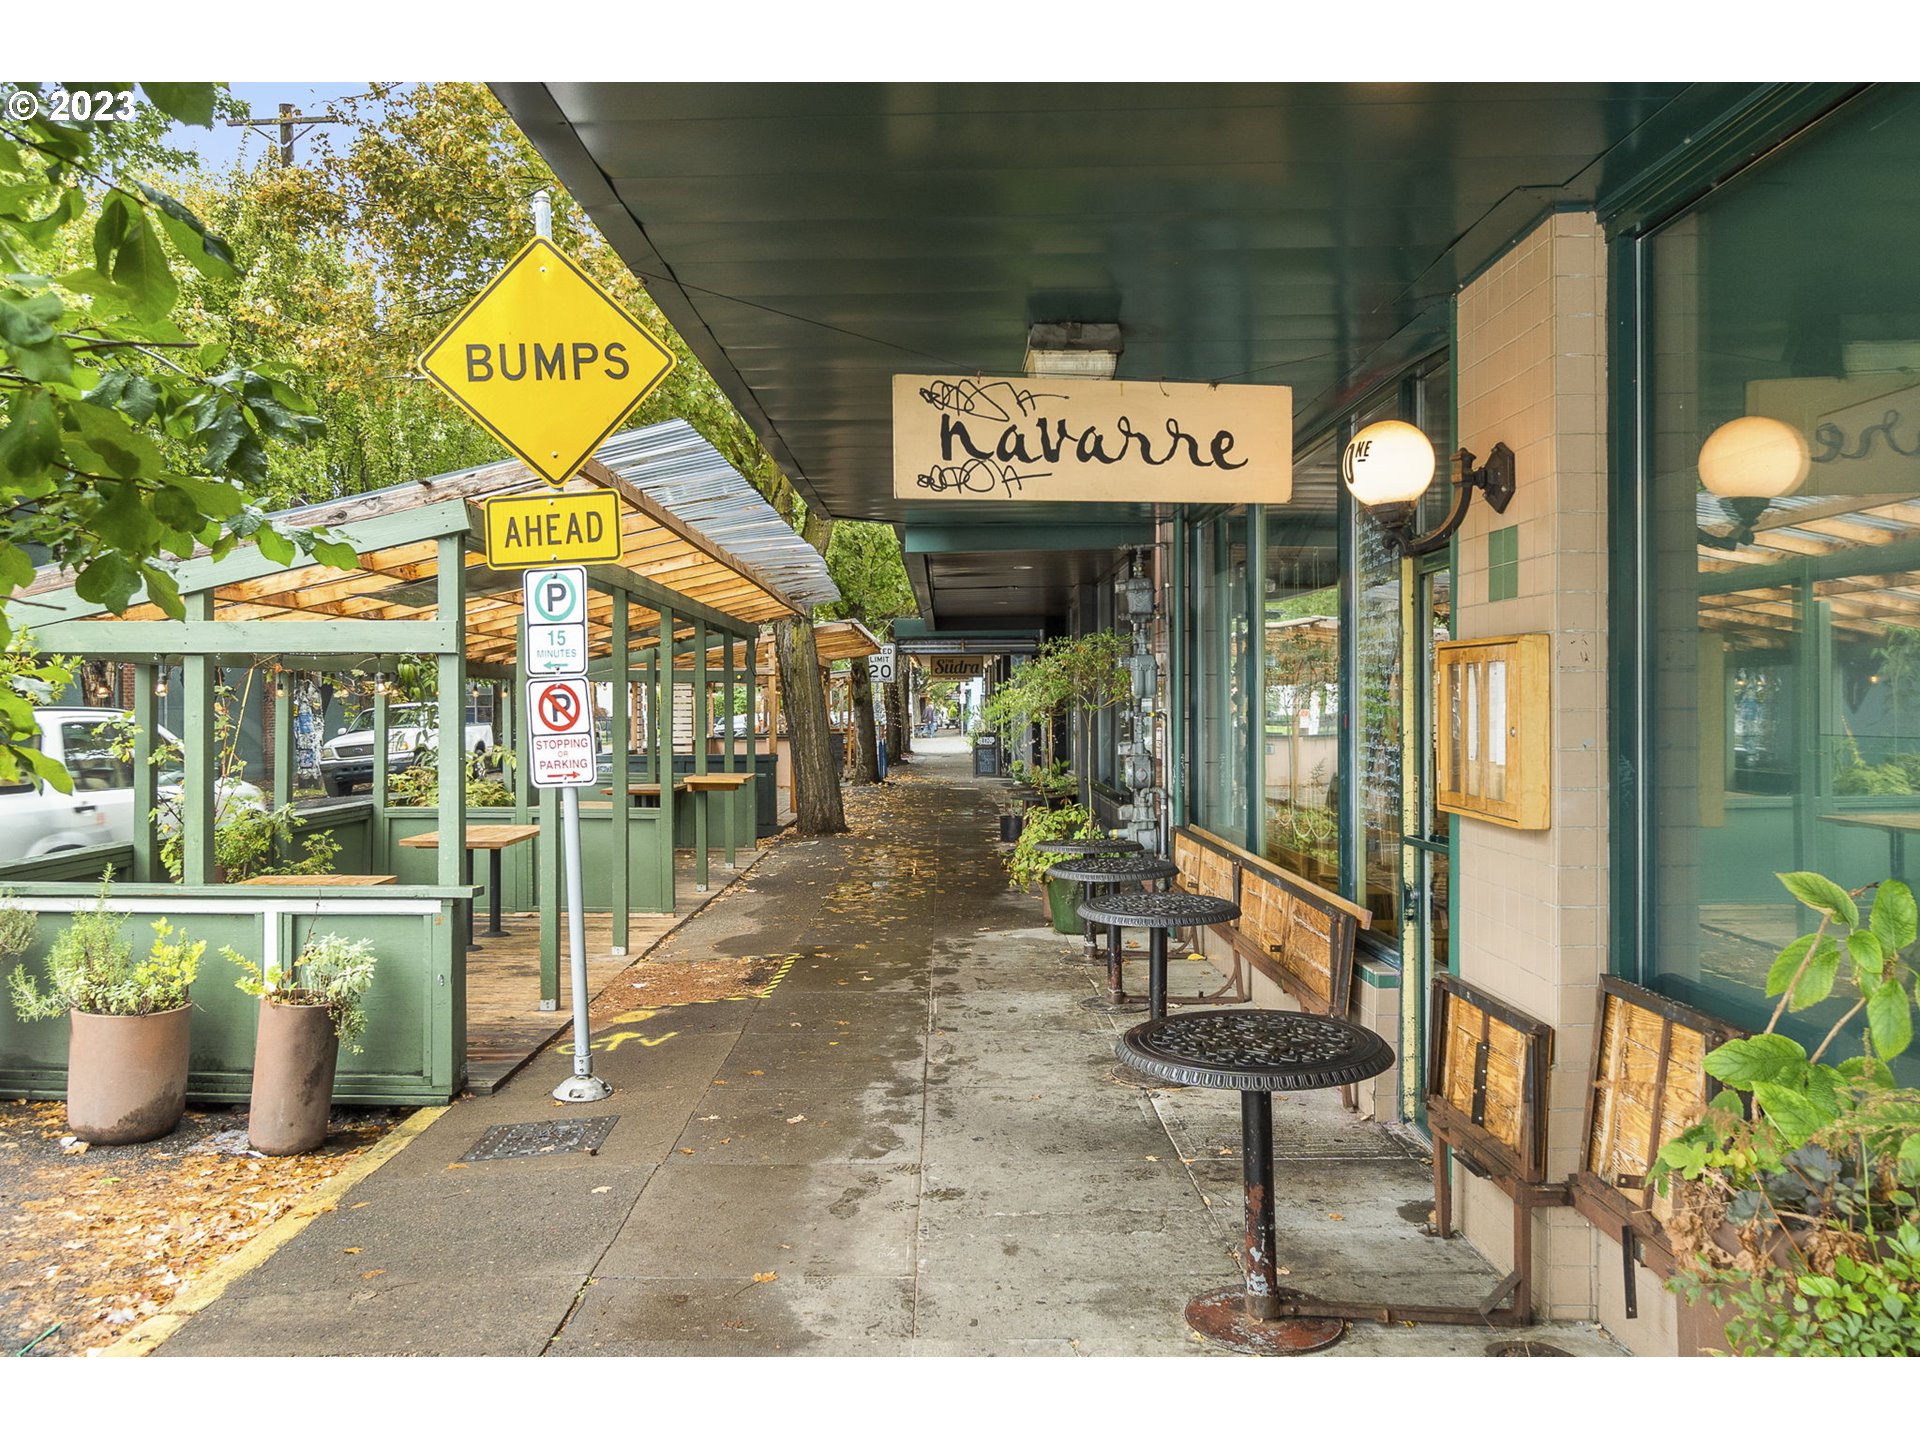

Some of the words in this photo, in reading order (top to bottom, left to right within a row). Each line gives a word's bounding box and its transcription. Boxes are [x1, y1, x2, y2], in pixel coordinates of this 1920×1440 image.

[466, 343, 629, 383] BUMPS
[940, 413, 1250, 471] navarre
[504, 511, 605, 549] AHEAD
[547, 630, 567, 646] 15
[536, 648, 577, 659] MINUTES
[869, 664, 892, 678] 20
[935, 659, 979, 674] Sudra
[535, 738, 589, 750] STOPPING
[558, 750, 569, 758] OR
[539, 759, 589, 770] PARKING
